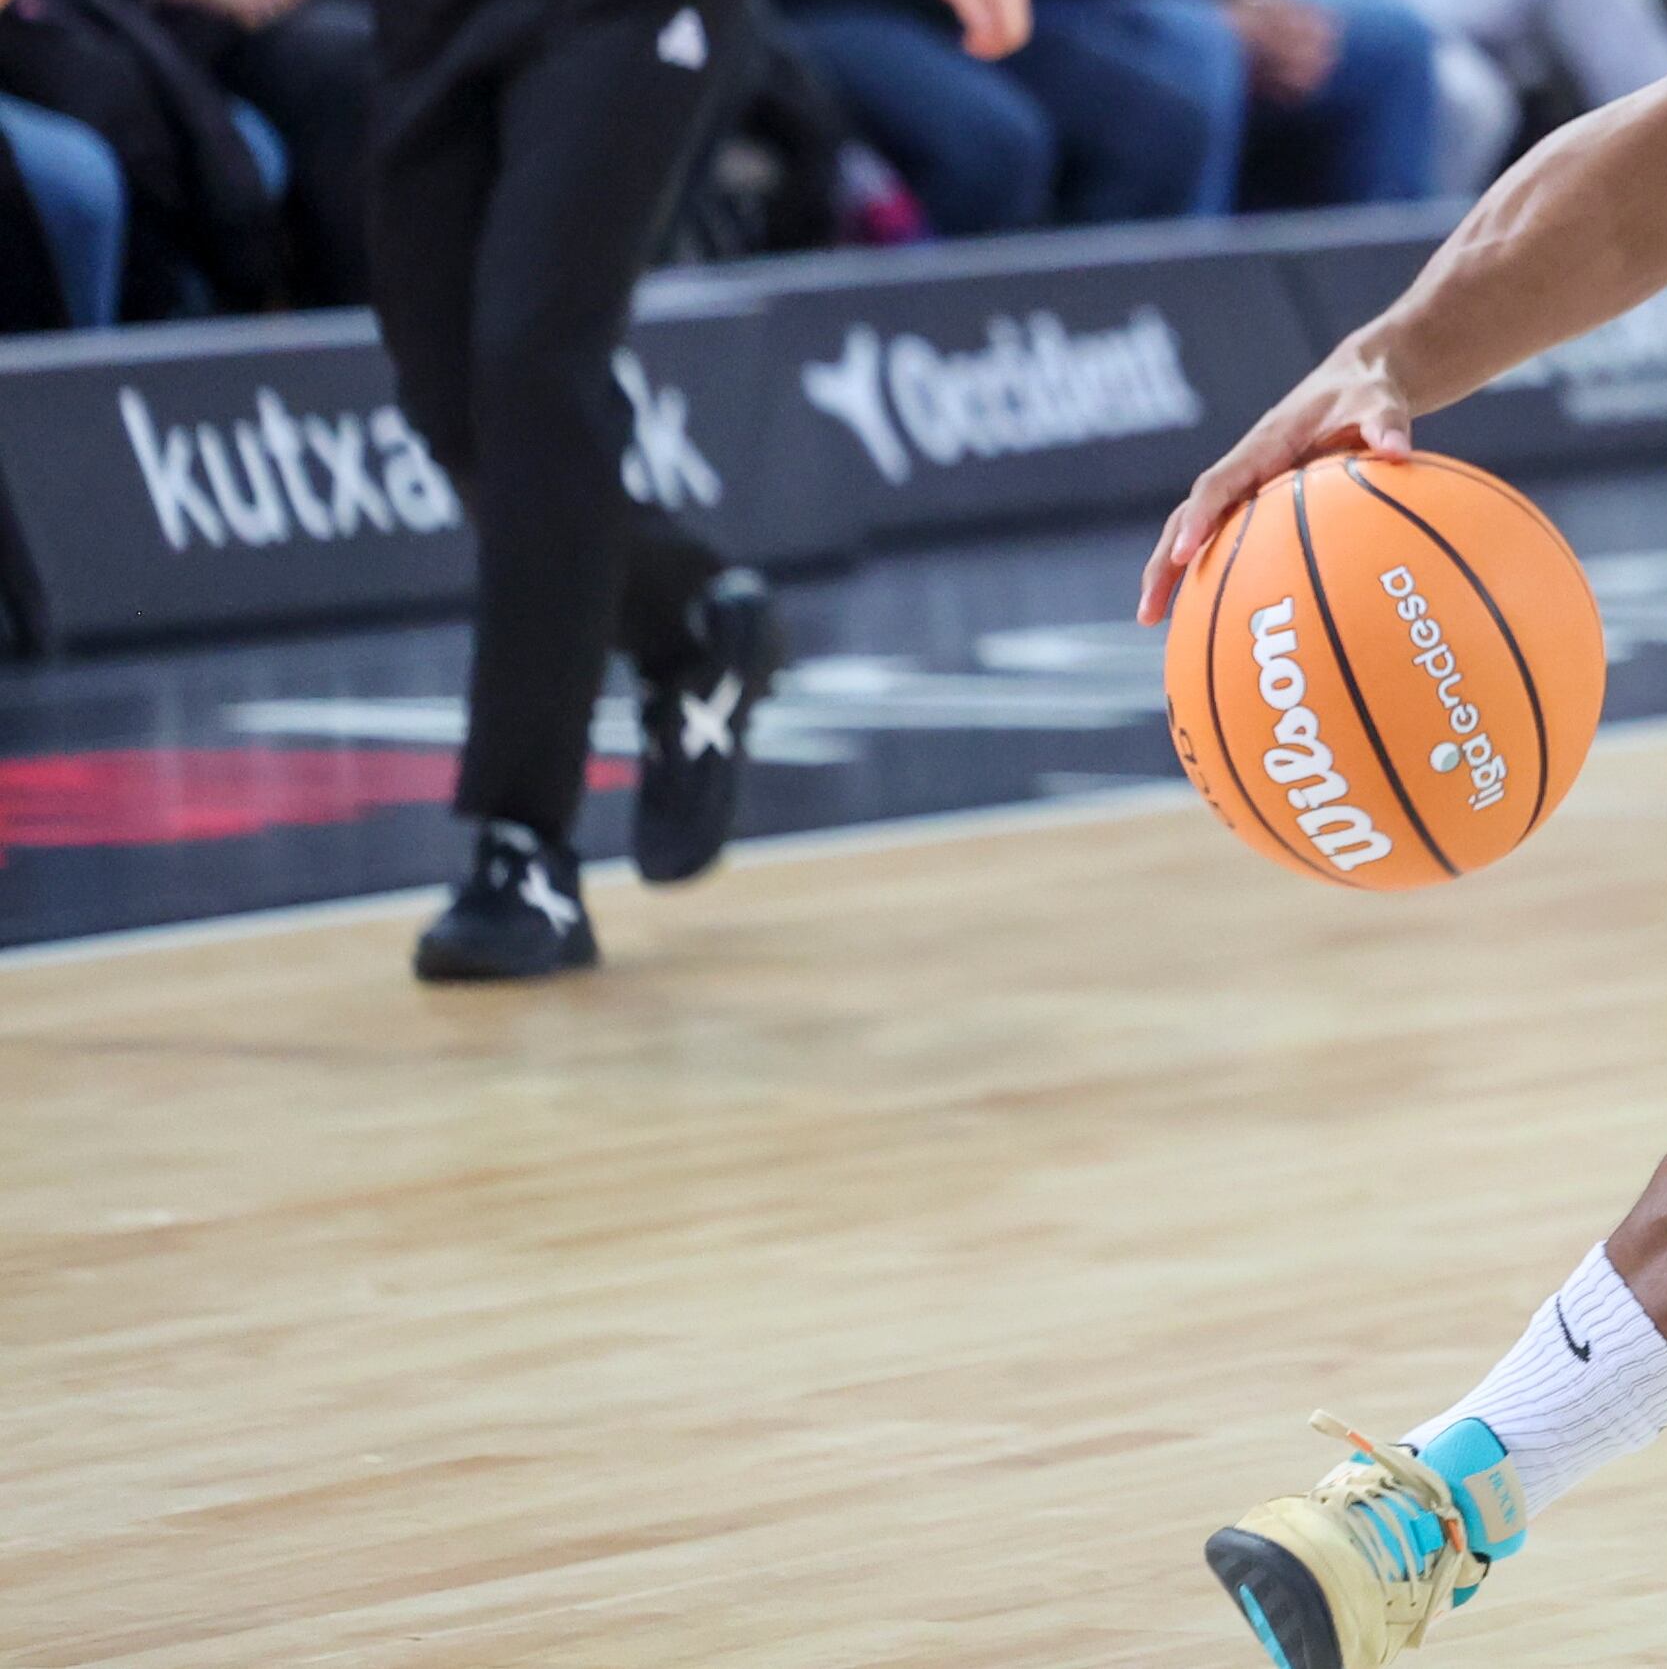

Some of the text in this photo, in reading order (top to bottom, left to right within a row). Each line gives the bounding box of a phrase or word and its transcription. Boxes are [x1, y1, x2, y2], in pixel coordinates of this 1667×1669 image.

[1249, 597, 1393, 872] Wilson
[1379, 565, 1508, 811] liga endesa
